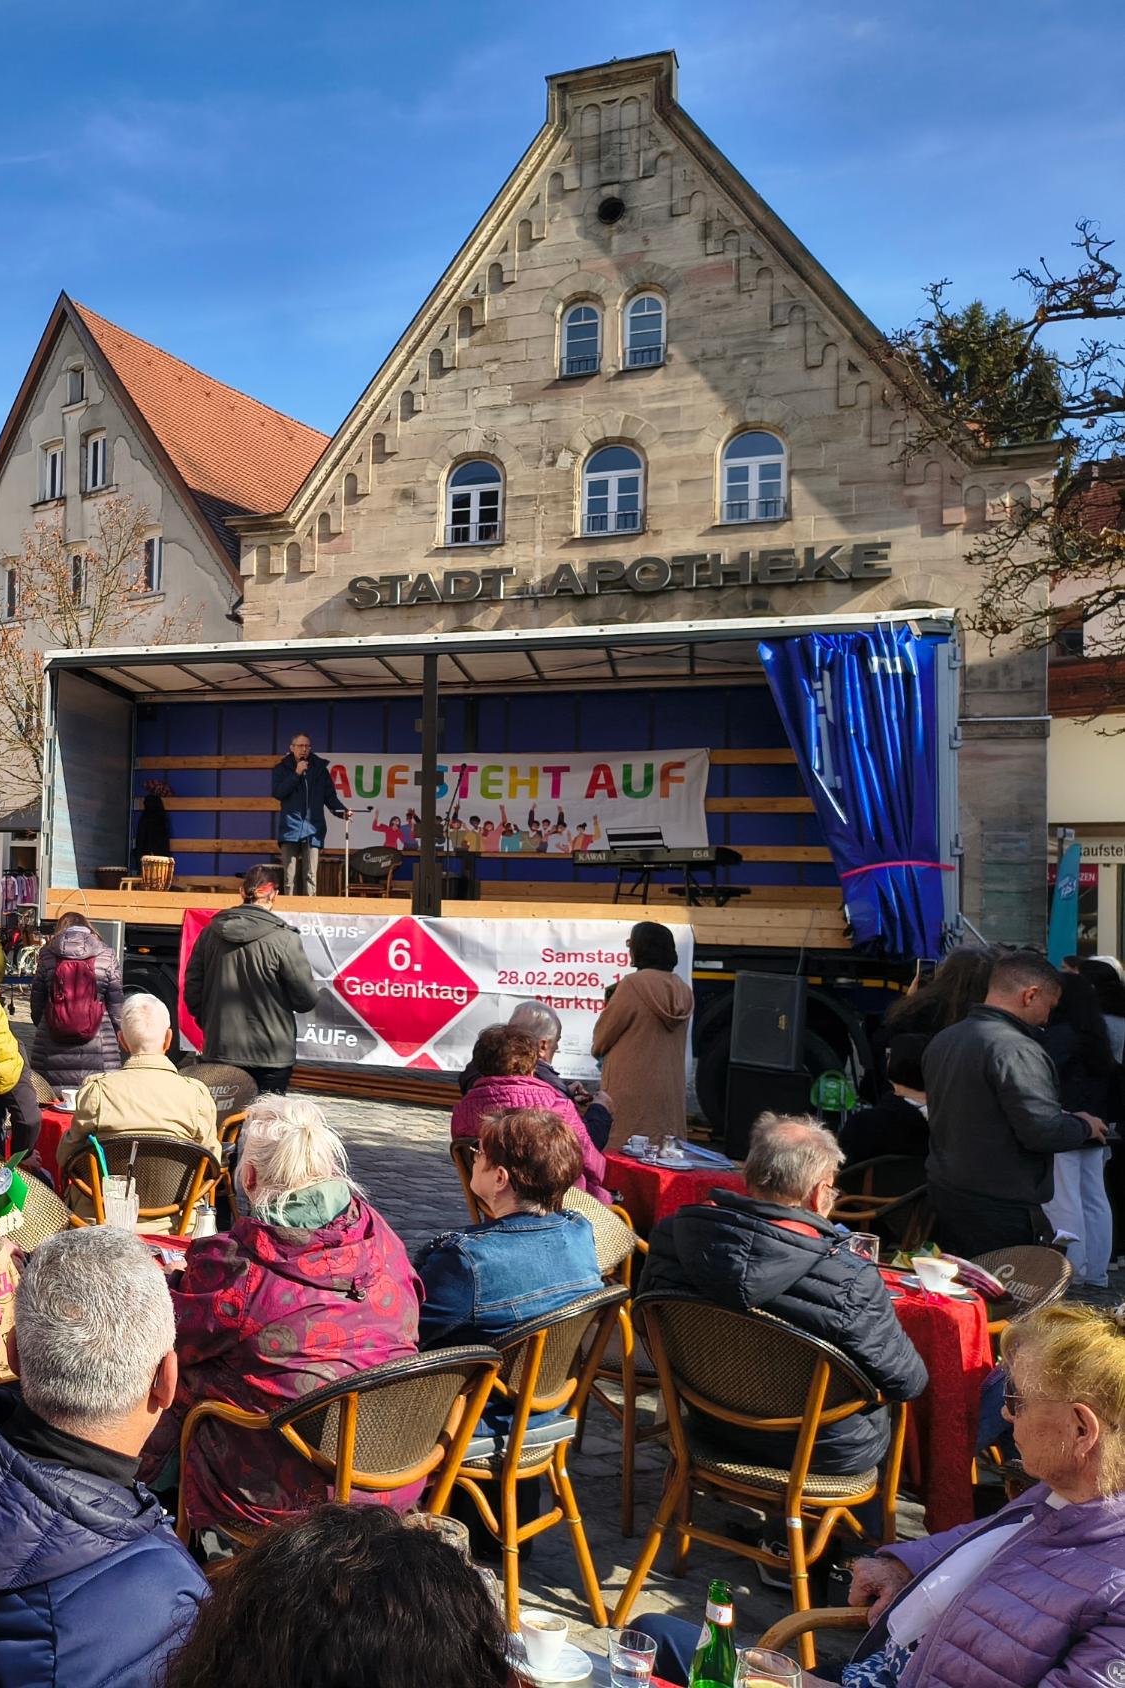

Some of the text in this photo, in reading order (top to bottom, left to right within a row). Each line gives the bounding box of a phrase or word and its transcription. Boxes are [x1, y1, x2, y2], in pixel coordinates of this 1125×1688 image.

[346, 541, 892, 609] STADT APOTHEKE
[330, 765, 409, 799] AUF
[585, 762, 686, 799] AUF
[578, 853, 606, 861] KAWAI
[1079, 844, 1125, 857] aufste
[299, 921, 367, 938] ebens-
[388, 938, 422, 972] 6.
[497, 970, 605, 990] 28.02.2026,
[343, 976, 468, 1005] Gedenktag
[535, 994, 607, 1014] Marktp
